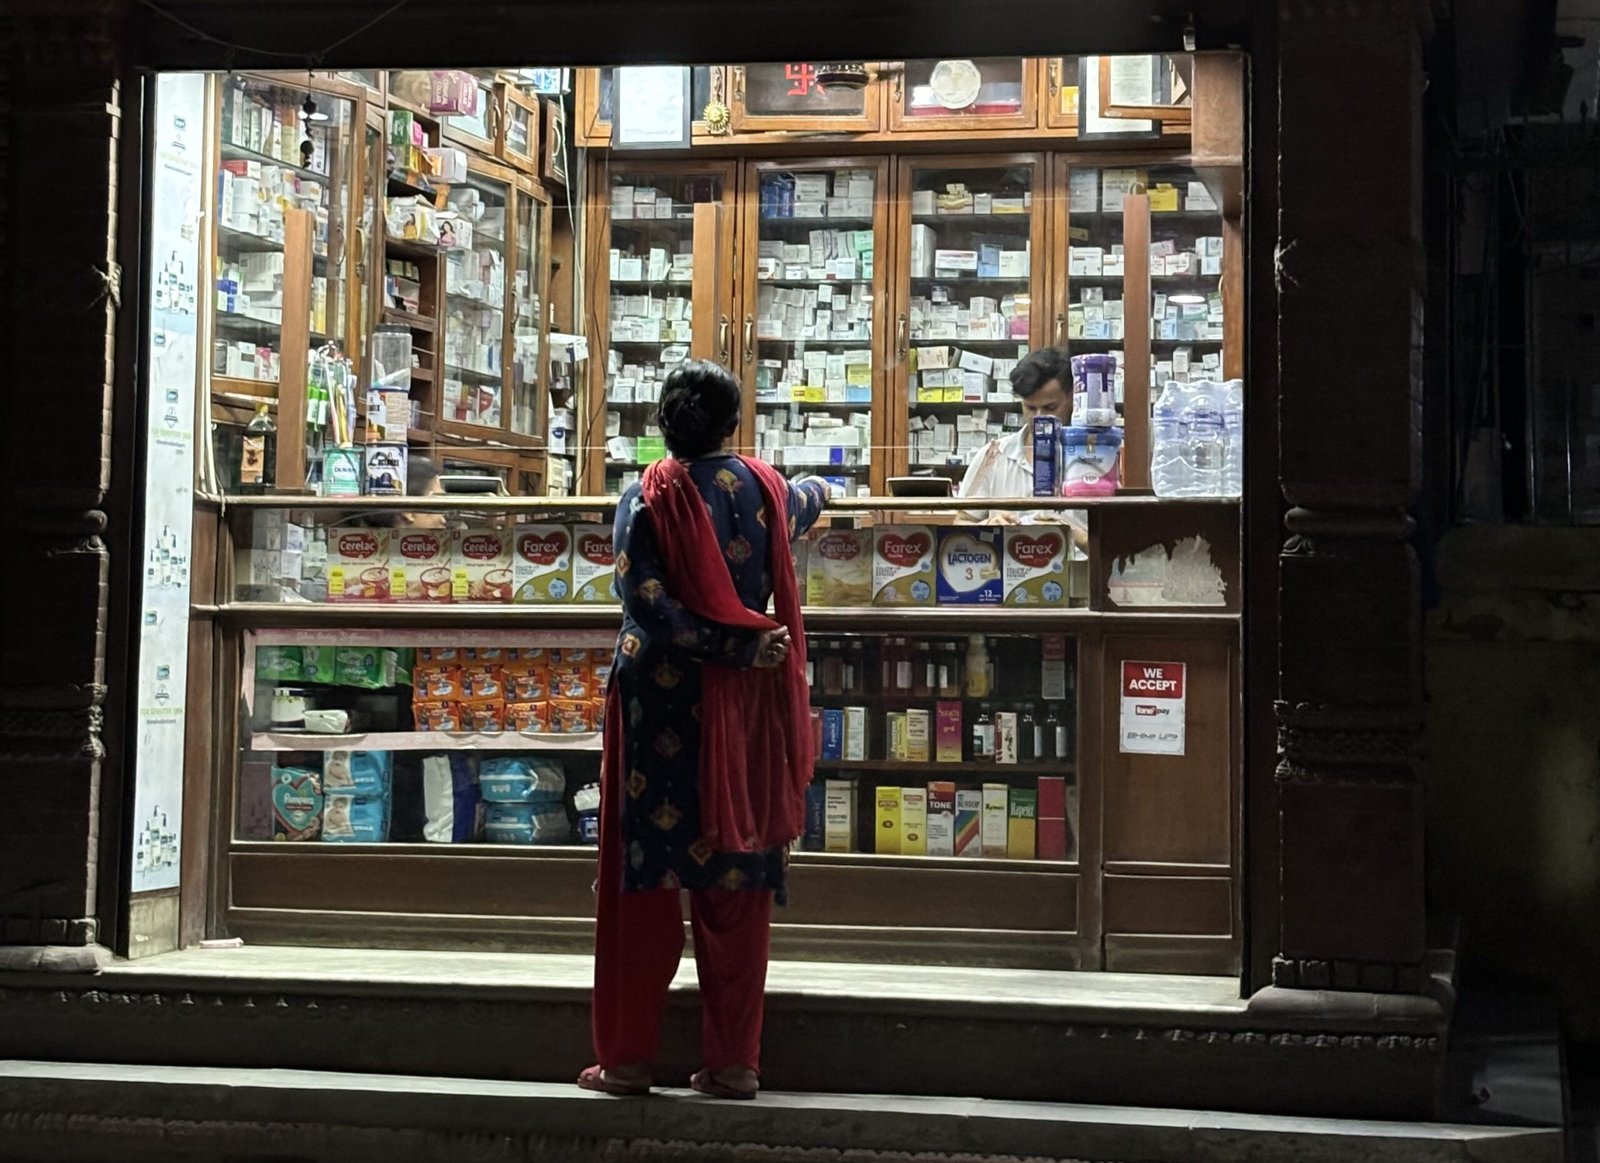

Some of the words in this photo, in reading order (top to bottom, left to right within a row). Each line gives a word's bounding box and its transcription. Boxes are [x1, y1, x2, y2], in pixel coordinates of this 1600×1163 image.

[340, 540, 375, 552] Cerelac
[401, 540, 437, 552] Cerelac
[463, 541, 499, 553] Cerelac
[523, 540, 560, 553] Farex
[584, 540, 614, 553] Fare
[820, 542, 857, 553] Cerelac
[884, 541, 922, 554] Farex
[1015, 542, 1053, 555] Farex
[948, 553, 991, 566] LACTOGEN
[965, 567, 973, 581] 3
[522, 584, 535, 600] 2
[583, 585, 596, 600] 2
[1014, 587, 1028, 604] 2
[1143, 667, 1163, 679] WE
[1129, 679, 1177, 691] ACCEPT
[929, 800, 952, 809] TONE
